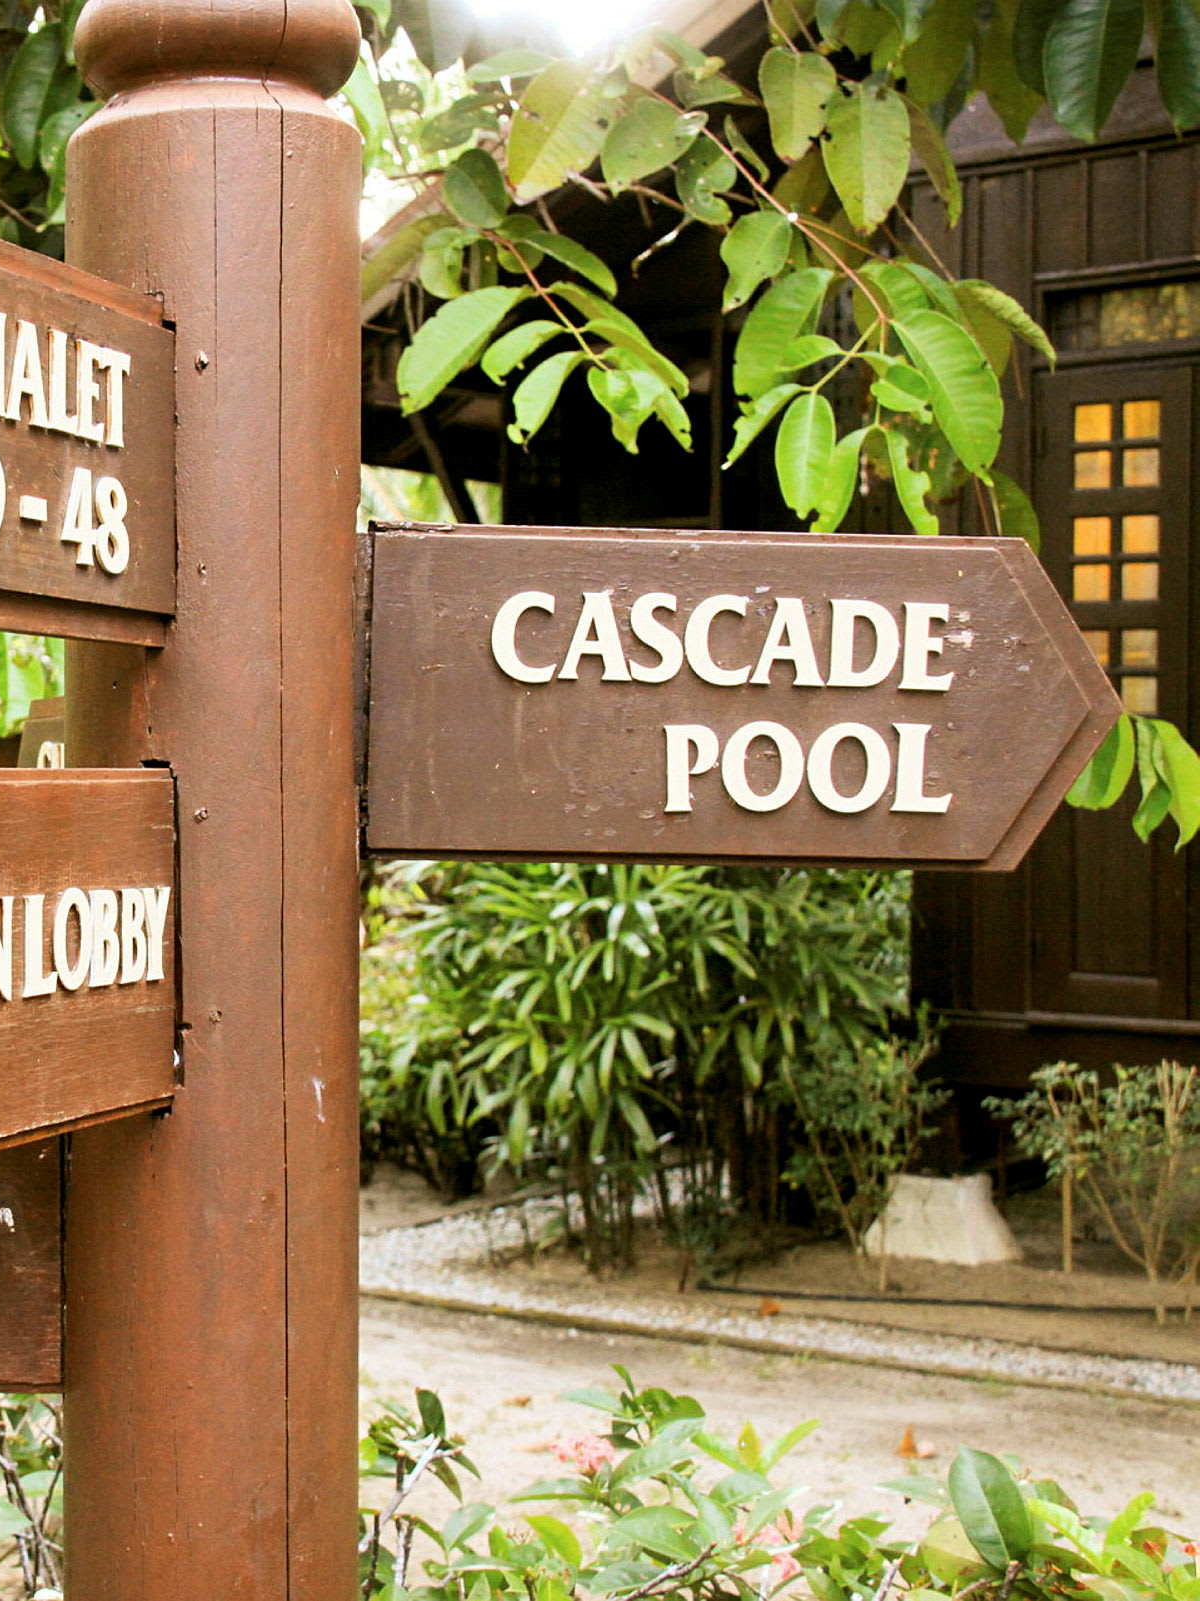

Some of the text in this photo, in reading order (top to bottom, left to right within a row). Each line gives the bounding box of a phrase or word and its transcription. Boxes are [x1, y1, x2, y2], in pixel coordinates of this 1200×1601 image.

[19, 494, 48, 523] -
[61, 466, 131, 574] 48
[491, 591, 954, 692] CASCADE
[664, 721, 953, 814] POOL
[22, 886, 172, 999] LOBBY
